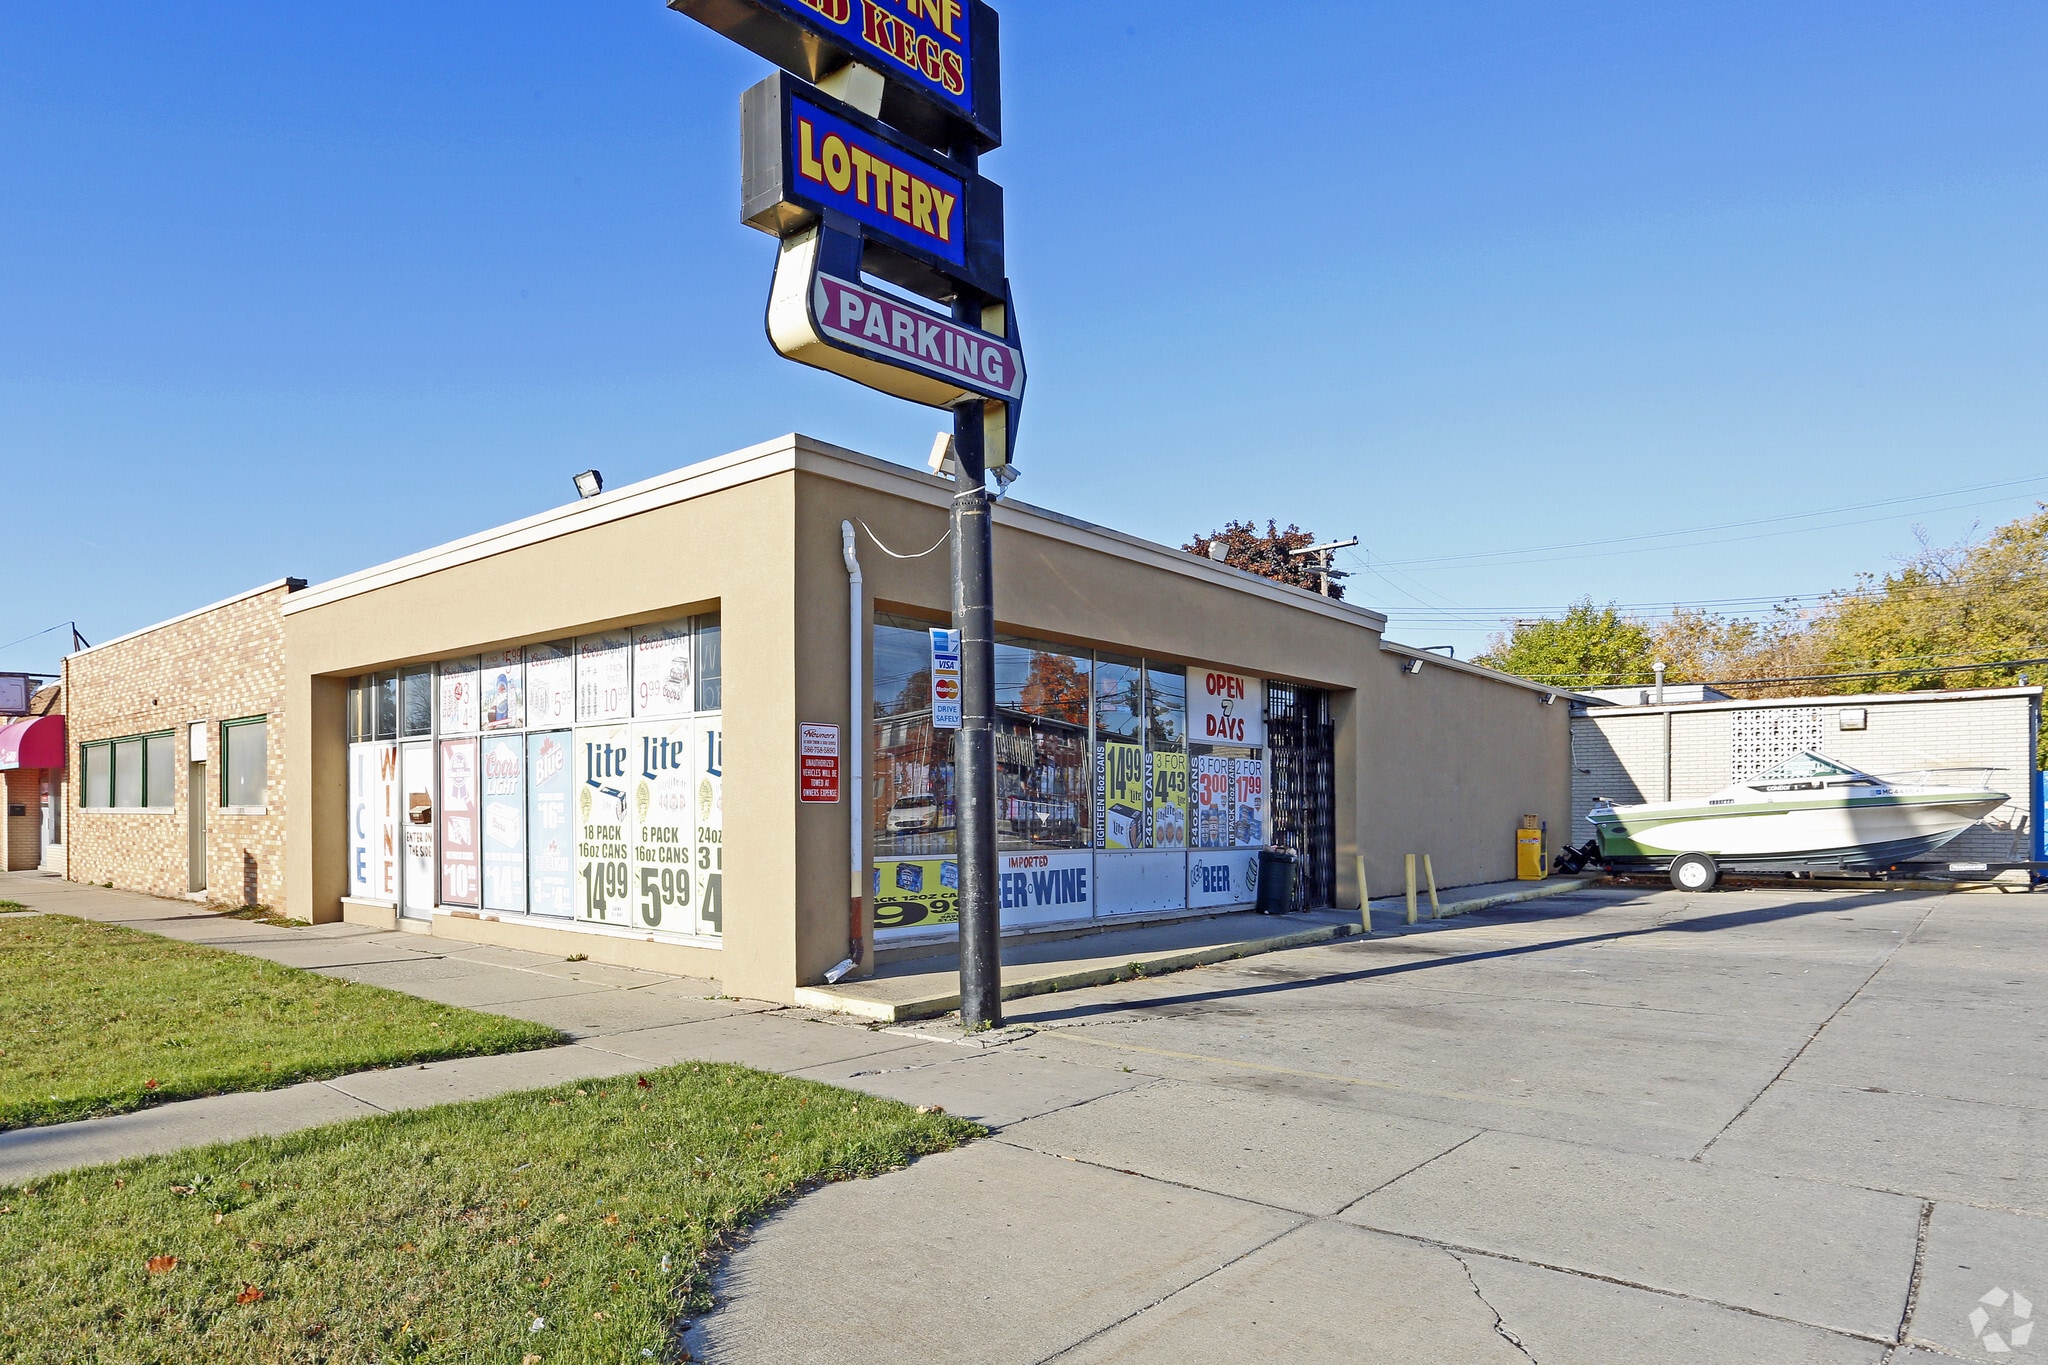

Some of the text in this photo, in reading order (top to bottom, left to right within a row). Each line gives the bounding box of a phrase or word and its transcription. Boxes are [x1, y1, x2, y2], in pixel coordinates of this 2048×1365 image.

[905, 0, 962, 43] NE
[862, 0, 965, 95] KEGS
[798, 115, 958, 243] LOTTERY
[839, 289, 1005, 385] PARKING
[939, 660, 955, 669] VISA
[1206, 673, 1244, 700] OPEN
[937, 705, 957, 713] DRIVE
[1221, 699, 1233, 717] 7
[936, 715, 959, 723] SAFELY
[1206, 714, 1244, 741] DAYS
[641, 735, 684, 780] Lite
[706, 730, 722, 777] Li
[1156, 753, 1186, 770] 3 FOR
[485, 751, 520, 779] Coors
[535, 748, 564, 787] Blue
[586, 742, 627, 788] Lite
[803, 769, 838, 777] VEHICLES WILL BE
[1200, 758, 1228, 774] 3 FOR
[1236, 760, 1262, 776] 2 FOR
[487, 779, 519, 796] LIGHT
[820, 789, 838, 797] EXPENSE
[1096, 746, 1105, 847] EIGHTEEN 16oz CANS
[1130, 789, 1141, 803] Lite
[1145, 752, 1153, 846] 24oz CANS
[1191, 757, 1199, 846] 24oz CANS
[356, 754, 367, 884] ICE
[380, 746, 398, 894] WINE
[1113, 820, 1124, 835] Lite
[406, 832, 433, 843] ENTER ON
[584, 825, 622, 841] 18 PACK
[642, 826, 679, 844] 6 PACK
[1229, 835, 1235, 843] 18
[408, 845, 419, 857] THE
[419, 845, 432, 858] SIDE
[579, 842, 628, 860] 16oz CANS
[634, 845, 689, 864] 16oz CANS
[698, 846, 711, 870] 3
[1008, 855, 1049, 869] IMPORTED
[1202, 865, 1230, 893] BEER
[901, 893, 936, 902] 12OZ
[999, 868, 1087, 910] ER WINE
